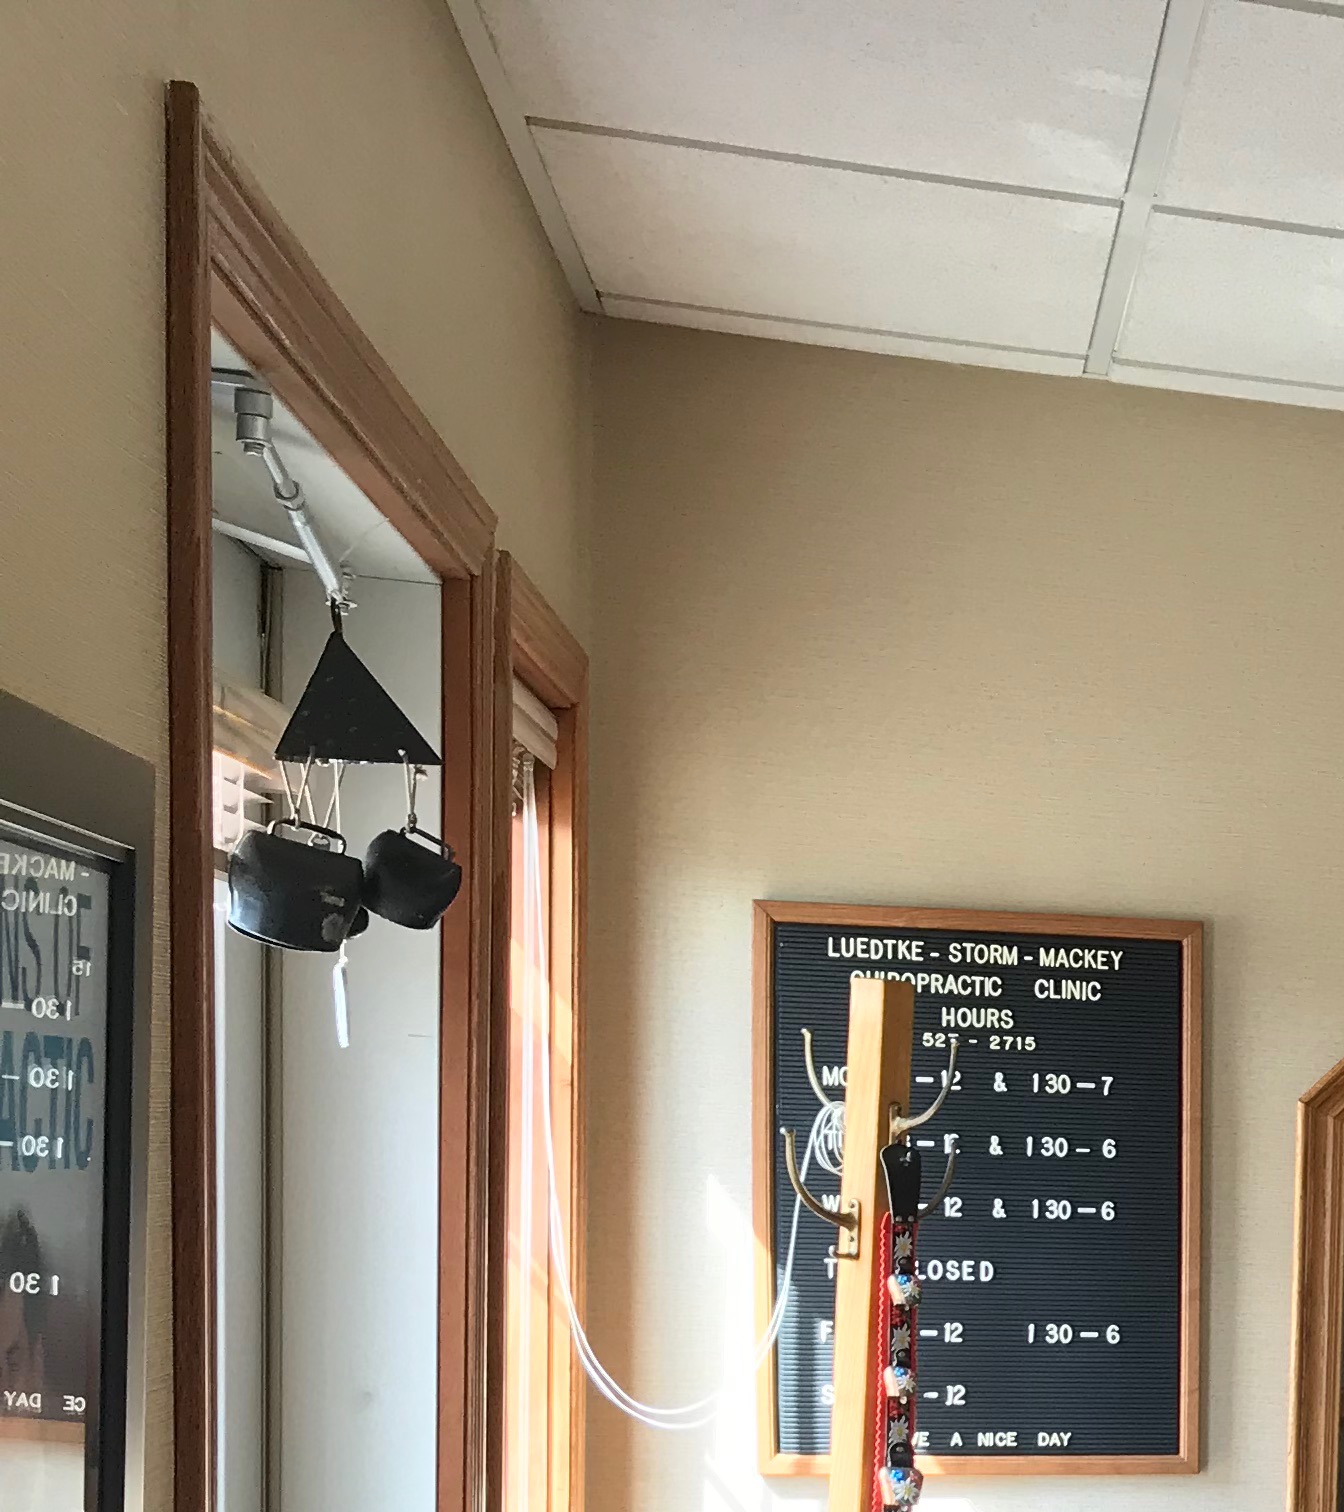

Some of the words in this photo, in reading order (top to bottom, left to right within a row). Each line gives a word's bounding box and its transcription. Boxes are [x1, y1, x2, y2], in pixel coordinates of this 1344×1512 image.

[827, 937, 925, 961] LUEDTKE
[948, 942, 1018, 966] STORM
[1039, 947, 1123, 971] MACKEY
[1035, 979, 1102, 1002] CLINIC
[941, 1006, 1014, 1030] HOURS
[989, 1035, 1036, 1051] 2715
[993, 1072, 1007, 1092] &
[989, 1135, 1004, 1155] &
[992, 1198, 1007, 1219] &
[915, 1258, 995, 1282] LOSED
[950, 1431, 963, 1447] A
[977, 1431, 1018, 1448] NICE
[1037, 1431, 1072, 1448] DAY
